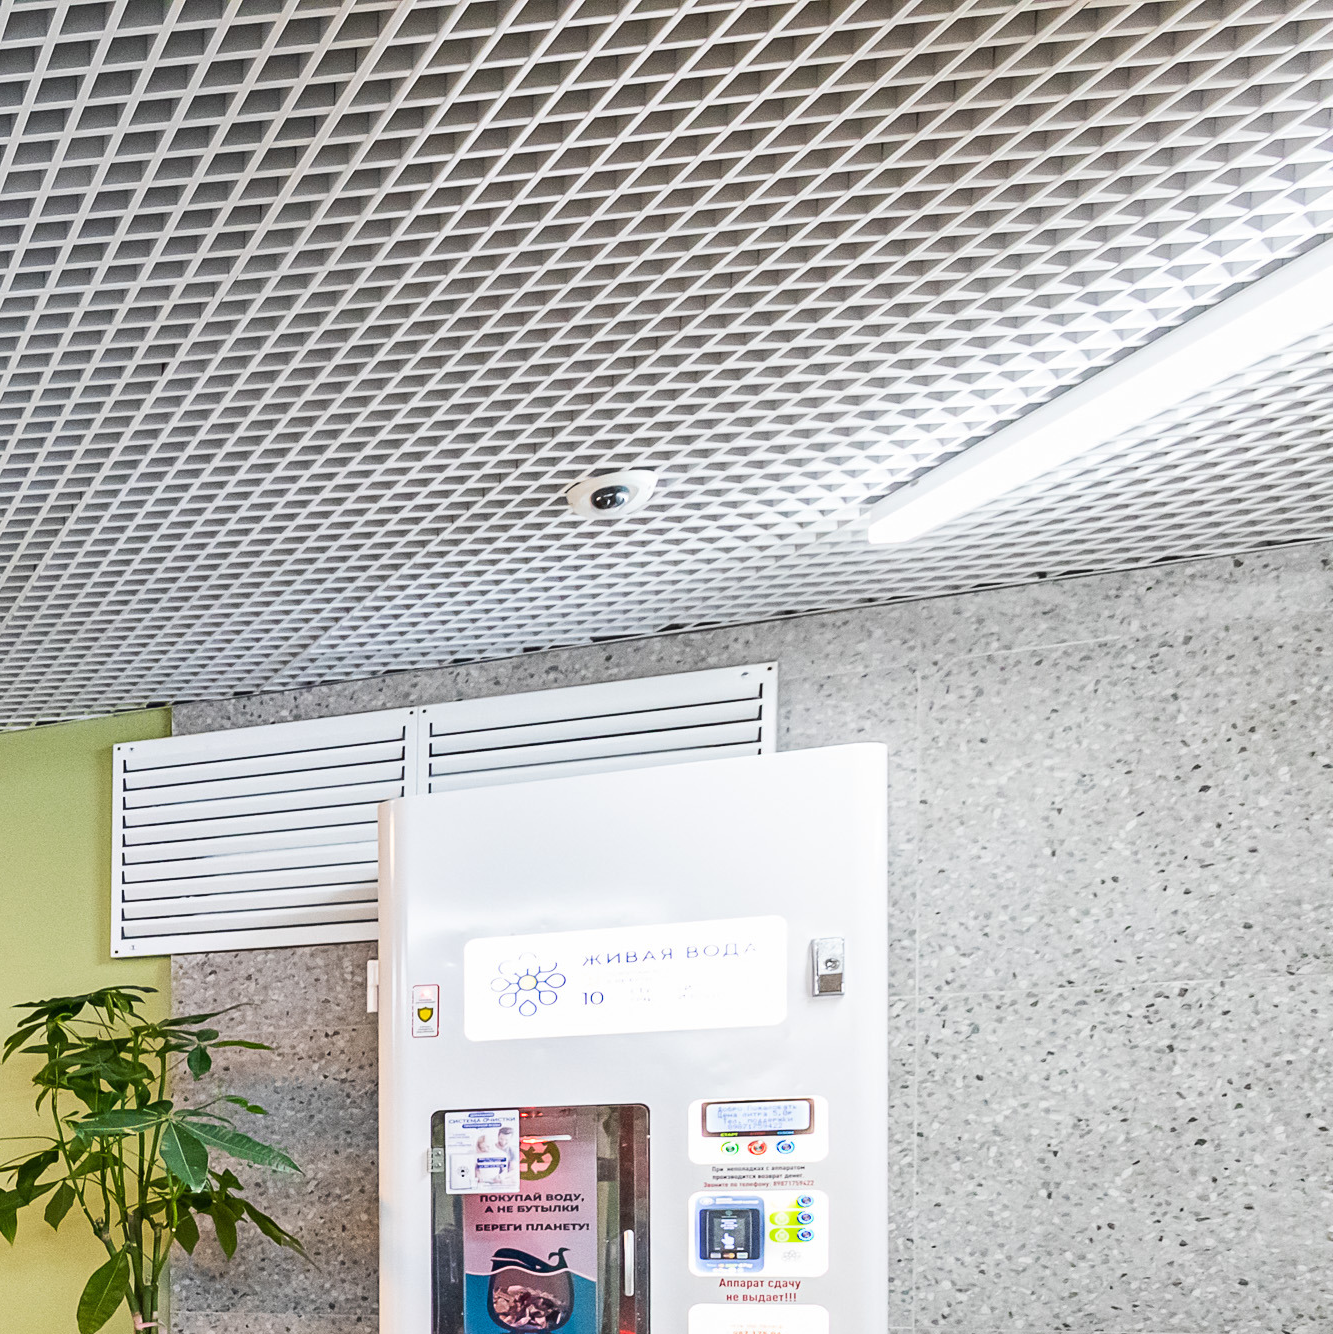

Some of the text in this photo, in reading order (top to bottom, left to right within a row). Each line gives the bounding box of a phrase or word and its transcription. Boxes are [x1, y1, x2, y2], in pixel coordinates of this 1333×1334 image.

[582, 942, 757, 967] ЖИВАЯ ВОДА
[712, 1165, 724, 1173] При
[480, 1192, 585, 1202] ПОКУПАЙ ВОДУ,
[484, 1204, 579, 1213] А НЕ БУТЫЛКИ
[475, 1222, 590, 1231] БЕРЕГИ ПЛАНЕТУ!
[718, 1278, 801, 1290] Аппарат сдачу
[742, 1293, 797, 1303] выдает!!!
